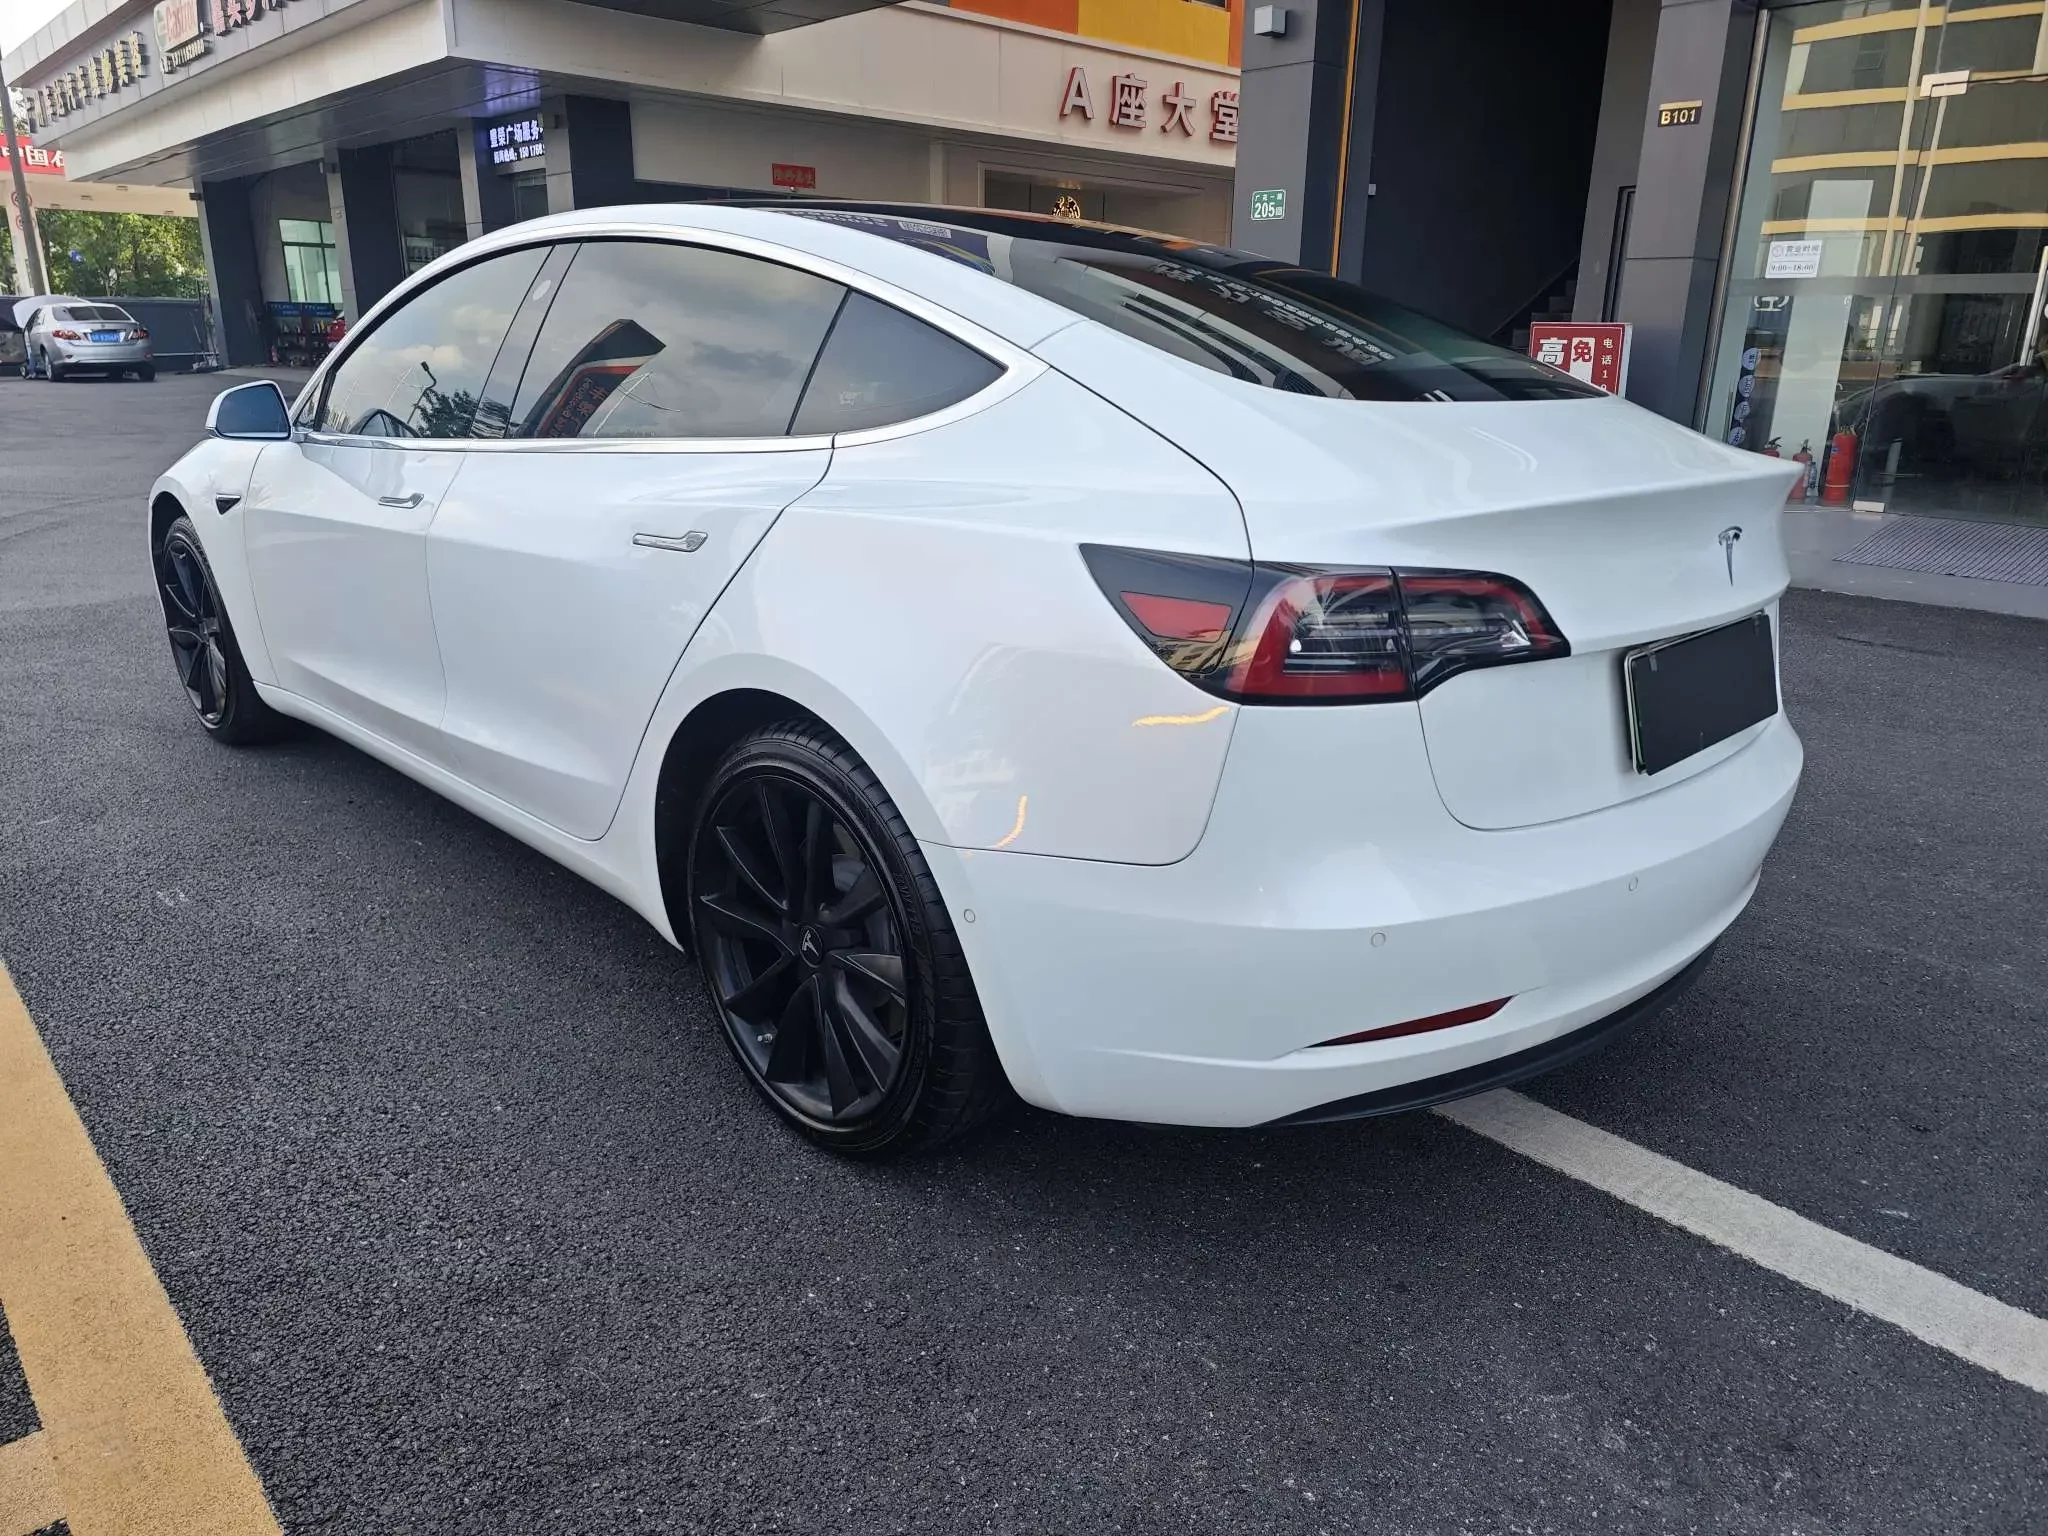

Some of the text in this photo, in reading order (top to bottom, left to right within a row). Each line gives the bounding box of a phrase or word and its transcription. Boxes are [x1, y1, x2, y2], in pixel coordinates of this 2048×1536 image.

[1059, 67, 1240, 143] A座大堂
[1661, 109, 1696, 125] B101
[1254, 202, 1275, 218] 205
